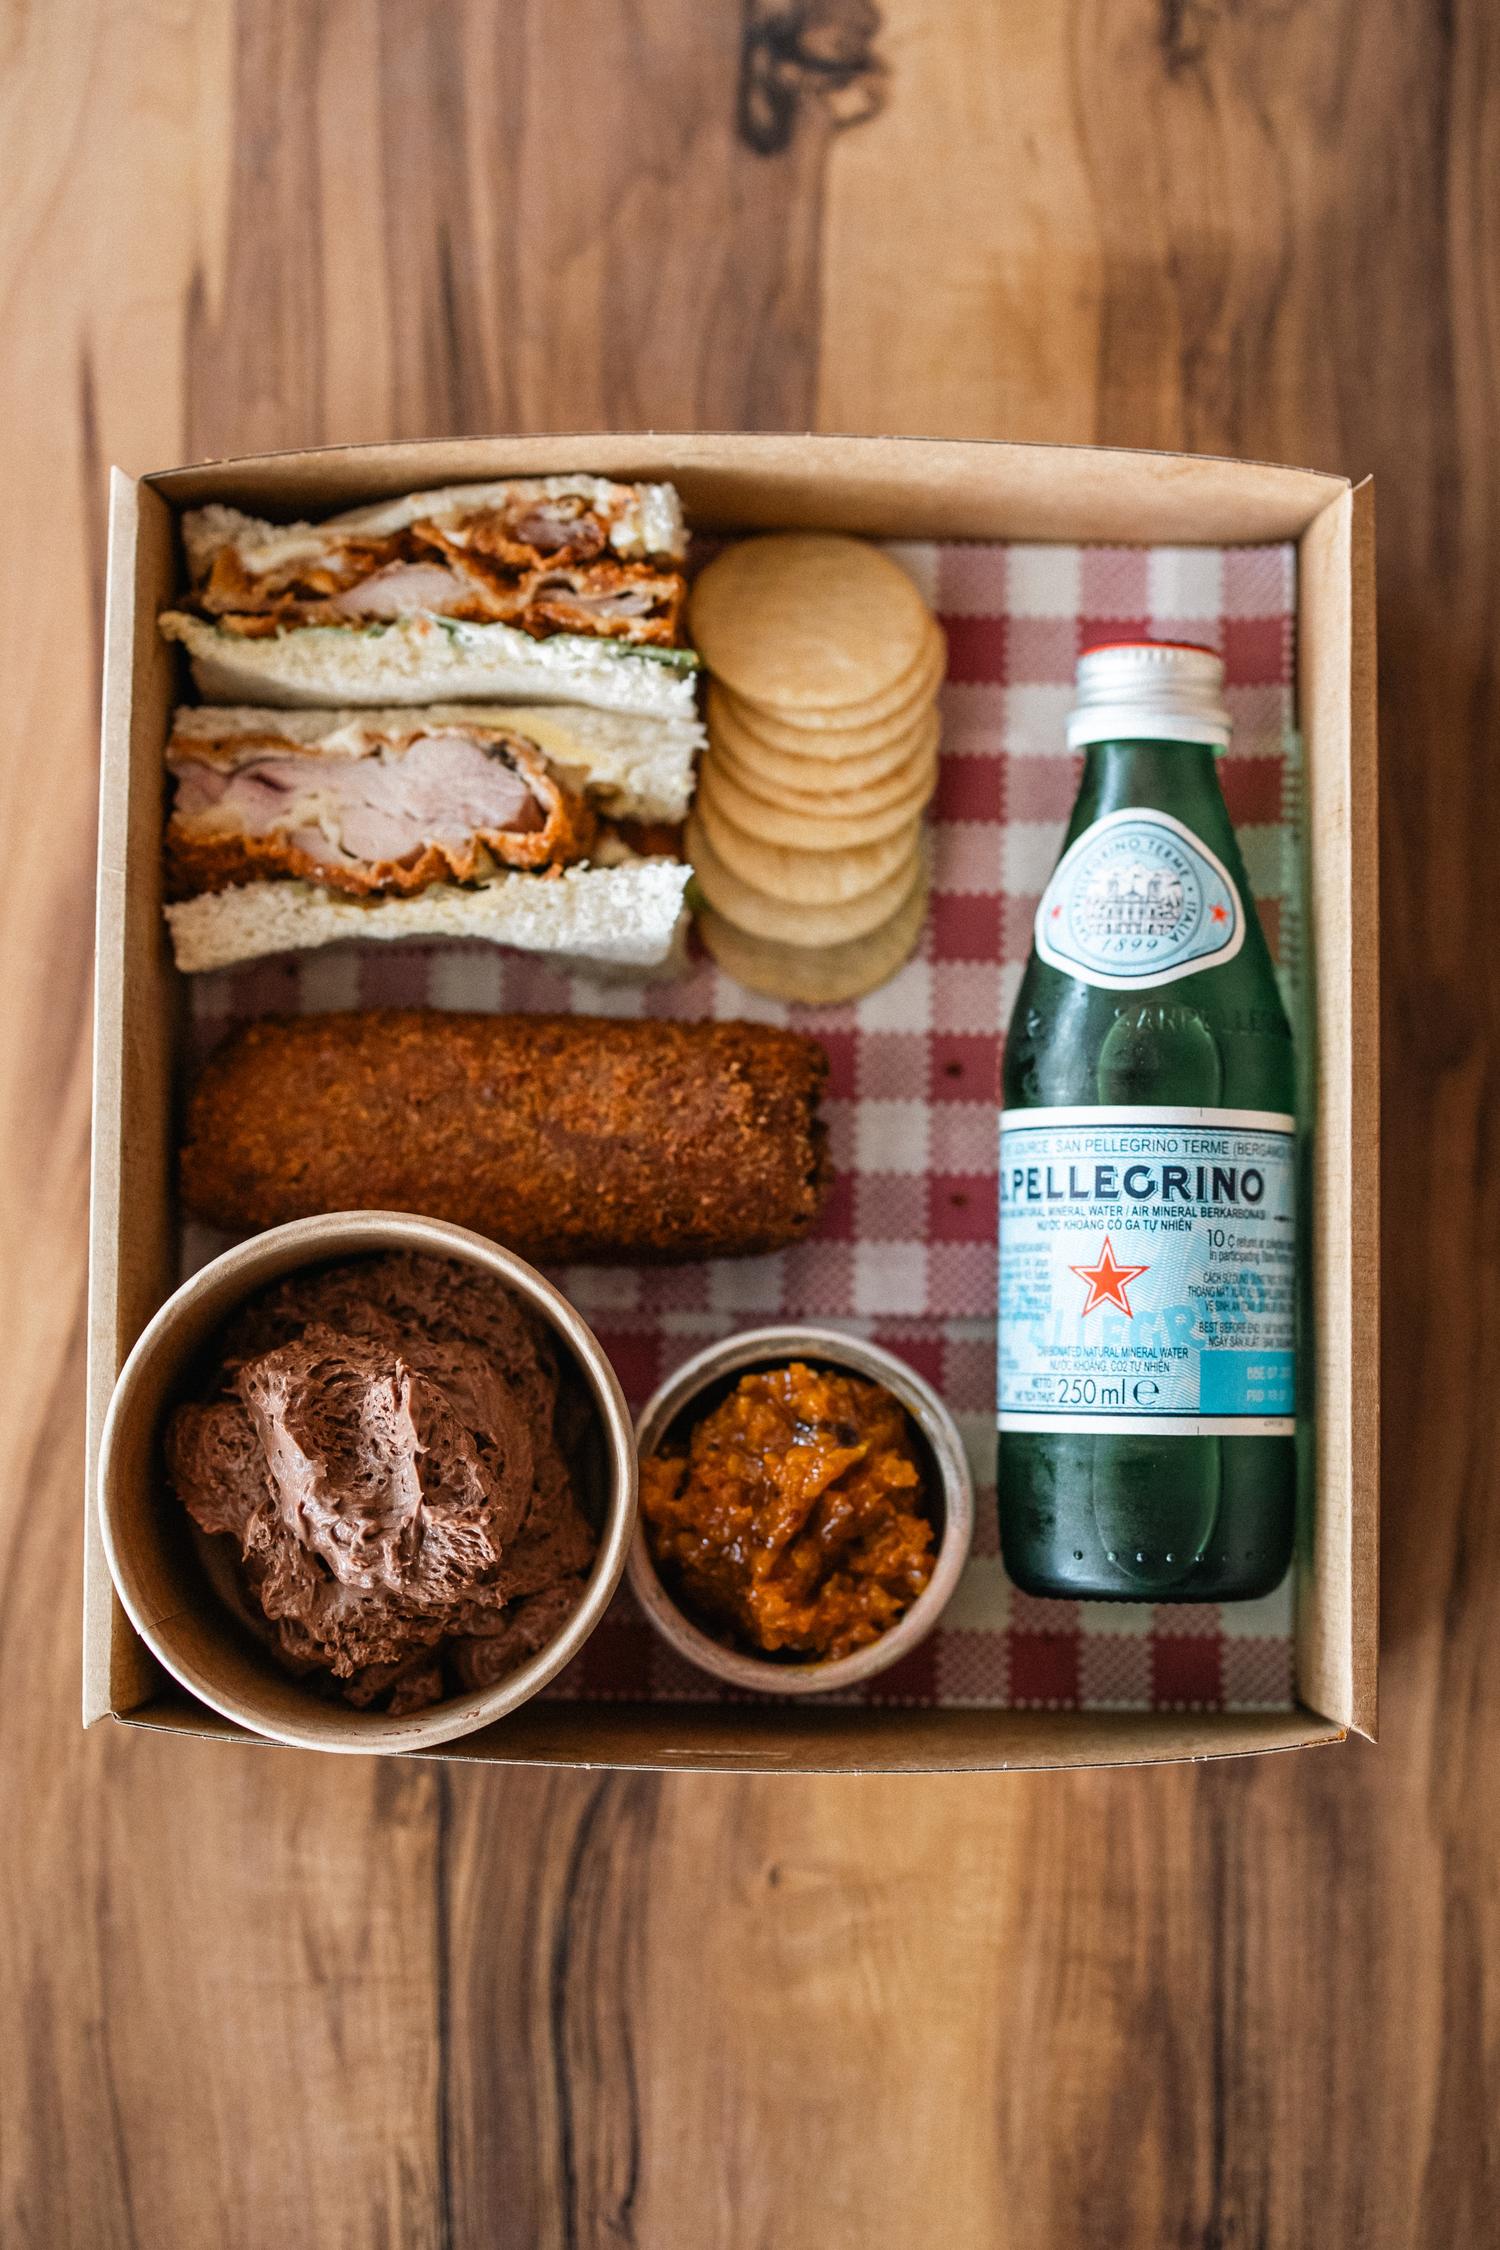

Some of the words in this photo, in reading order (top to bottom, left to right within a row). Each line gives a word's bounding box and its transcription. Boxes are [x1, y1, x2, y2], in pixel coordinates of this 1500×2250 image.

[1147, 839, 1190, 879] TERME
[1168, 901, 1197, 943] ITALIA
[1101, 937, 1159, 953] 1899
[1084, 1137, 1178, 1152] PELLEGRINO
[1182, 1138, 1230, 1154] TERME
[1088, 1205, 1123, 1217] WATER
[1131, 1205, 1150, 1217] AIR
[1152, 1205, 1198, 1218] MINERAL
[1125, 1219, 1141, 1231] GA
[1207, 1228, 1226, 1248] 10
[1198, 1321, 1218, 1334] BEST
[1120, 1346, 1158, 1359] MINERAL
[1159, 1346, 1189, 1359] WATER
[1057, 1378, 1097, 1404] 250
[1101, 1378, 1125, 1405] ml
